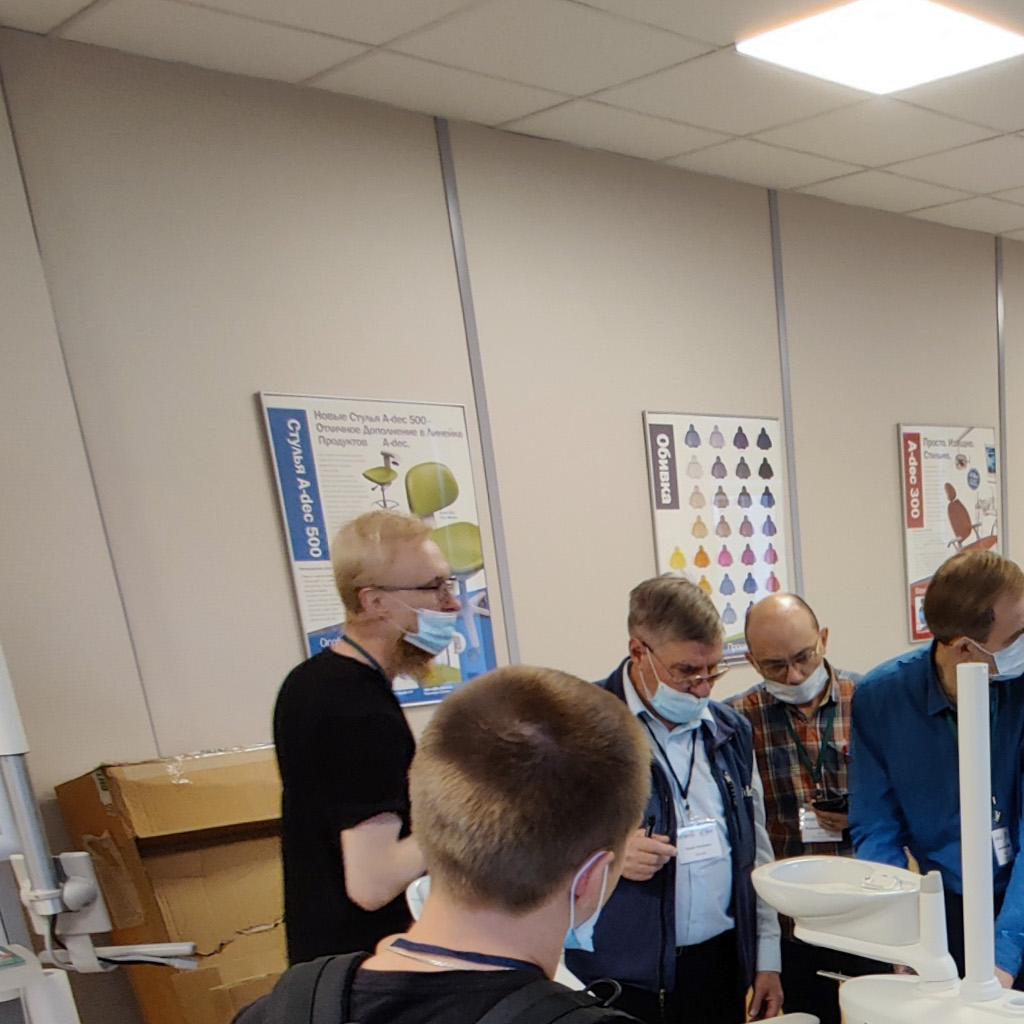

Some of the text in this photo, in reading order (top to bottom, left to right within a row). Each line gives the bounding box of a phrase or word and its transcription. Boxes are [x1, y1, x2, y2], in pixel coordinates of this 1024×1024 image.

[313, 410, 348, 422] Новые
[350, 411, 380, 424] Стулья
[285, 417, 306, 475] Стулья
[305, 526, 322, 558] 500
[655, 433, 673, 506] Обивка
[907, 440, 920, 519] A-dec 300
